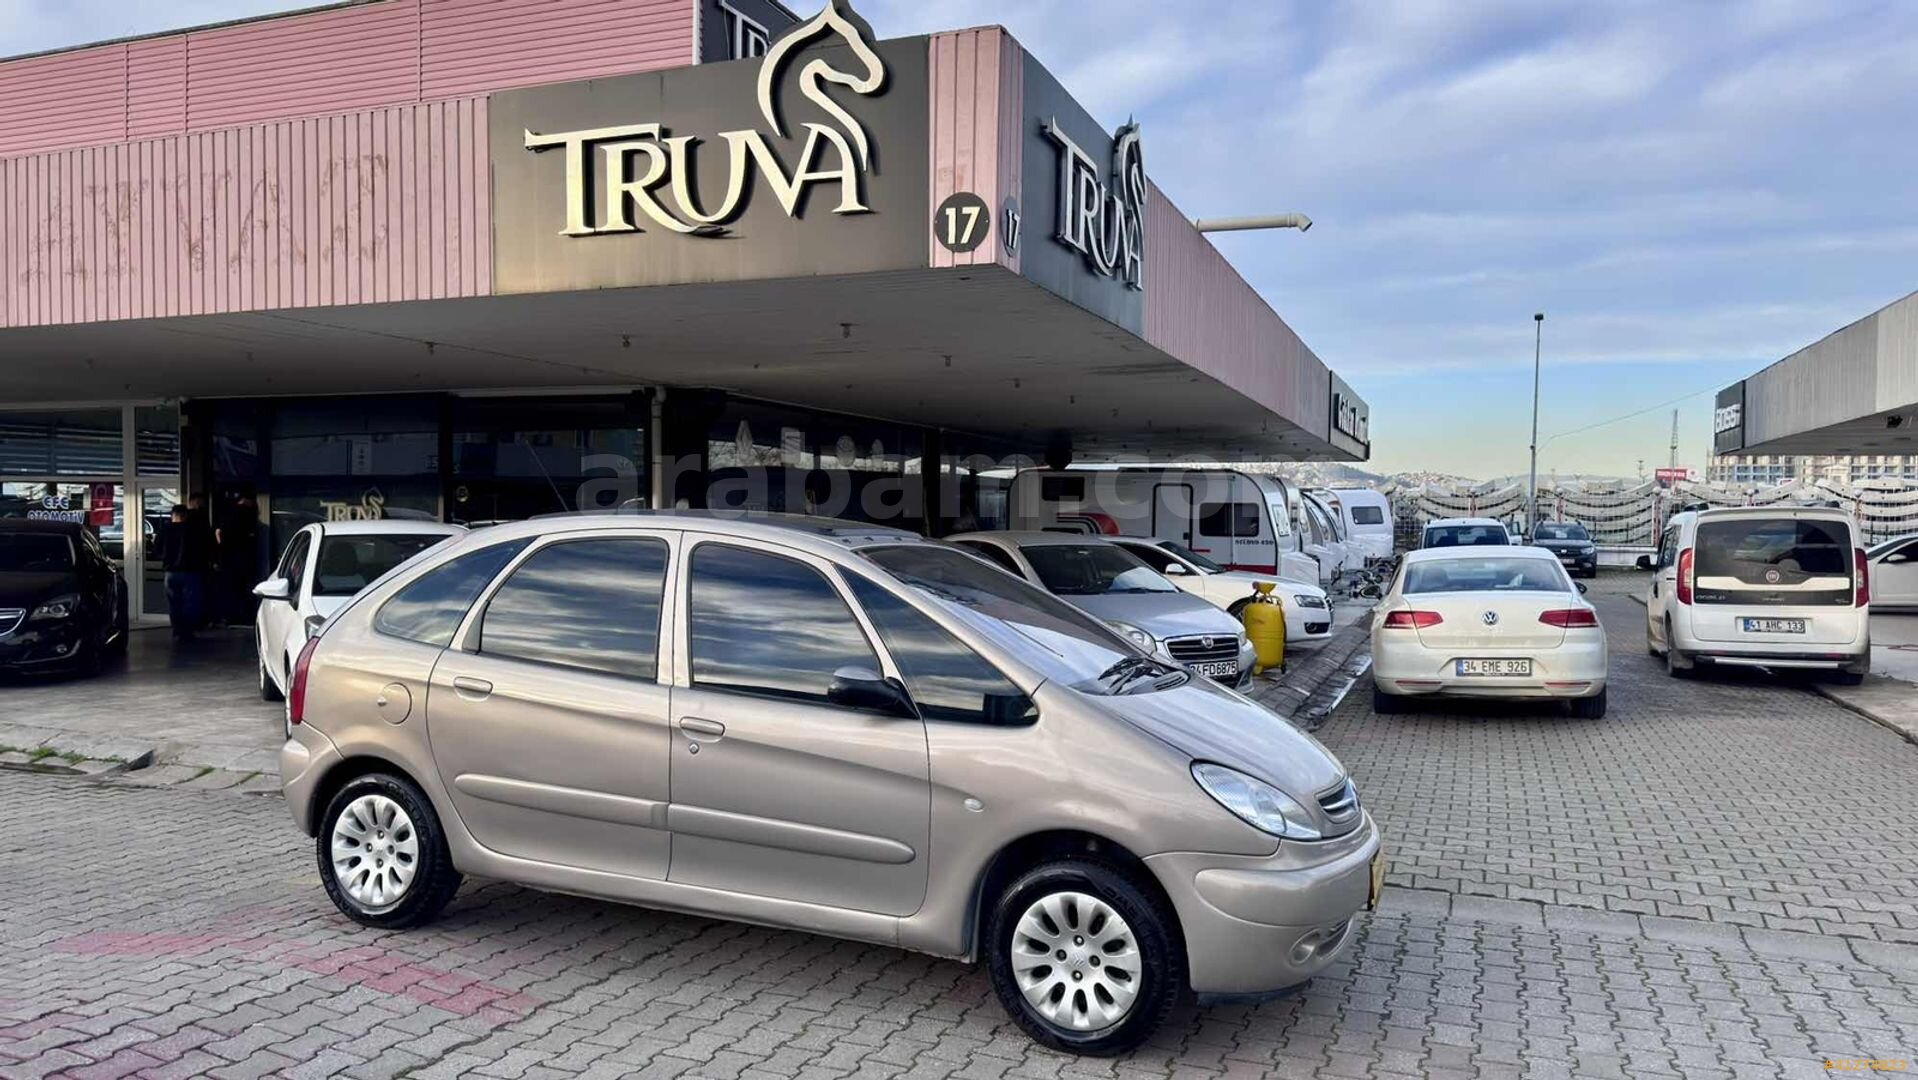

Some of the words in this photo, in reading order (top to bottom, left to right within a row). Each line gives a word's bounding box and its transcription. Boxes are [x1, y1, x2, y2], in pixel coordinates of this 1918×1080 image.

[525, 123, 872, 236] TRUVA
[1052, 113, 1145, 291] TRUVA
[945, 206, 980, 244] 17
[43, 496, 69, 509] EFE
[1464, 661, 1476, 673] 34
[1481, 661, 1501, 673] EME
[1507, 661, 1527, 673] 926
